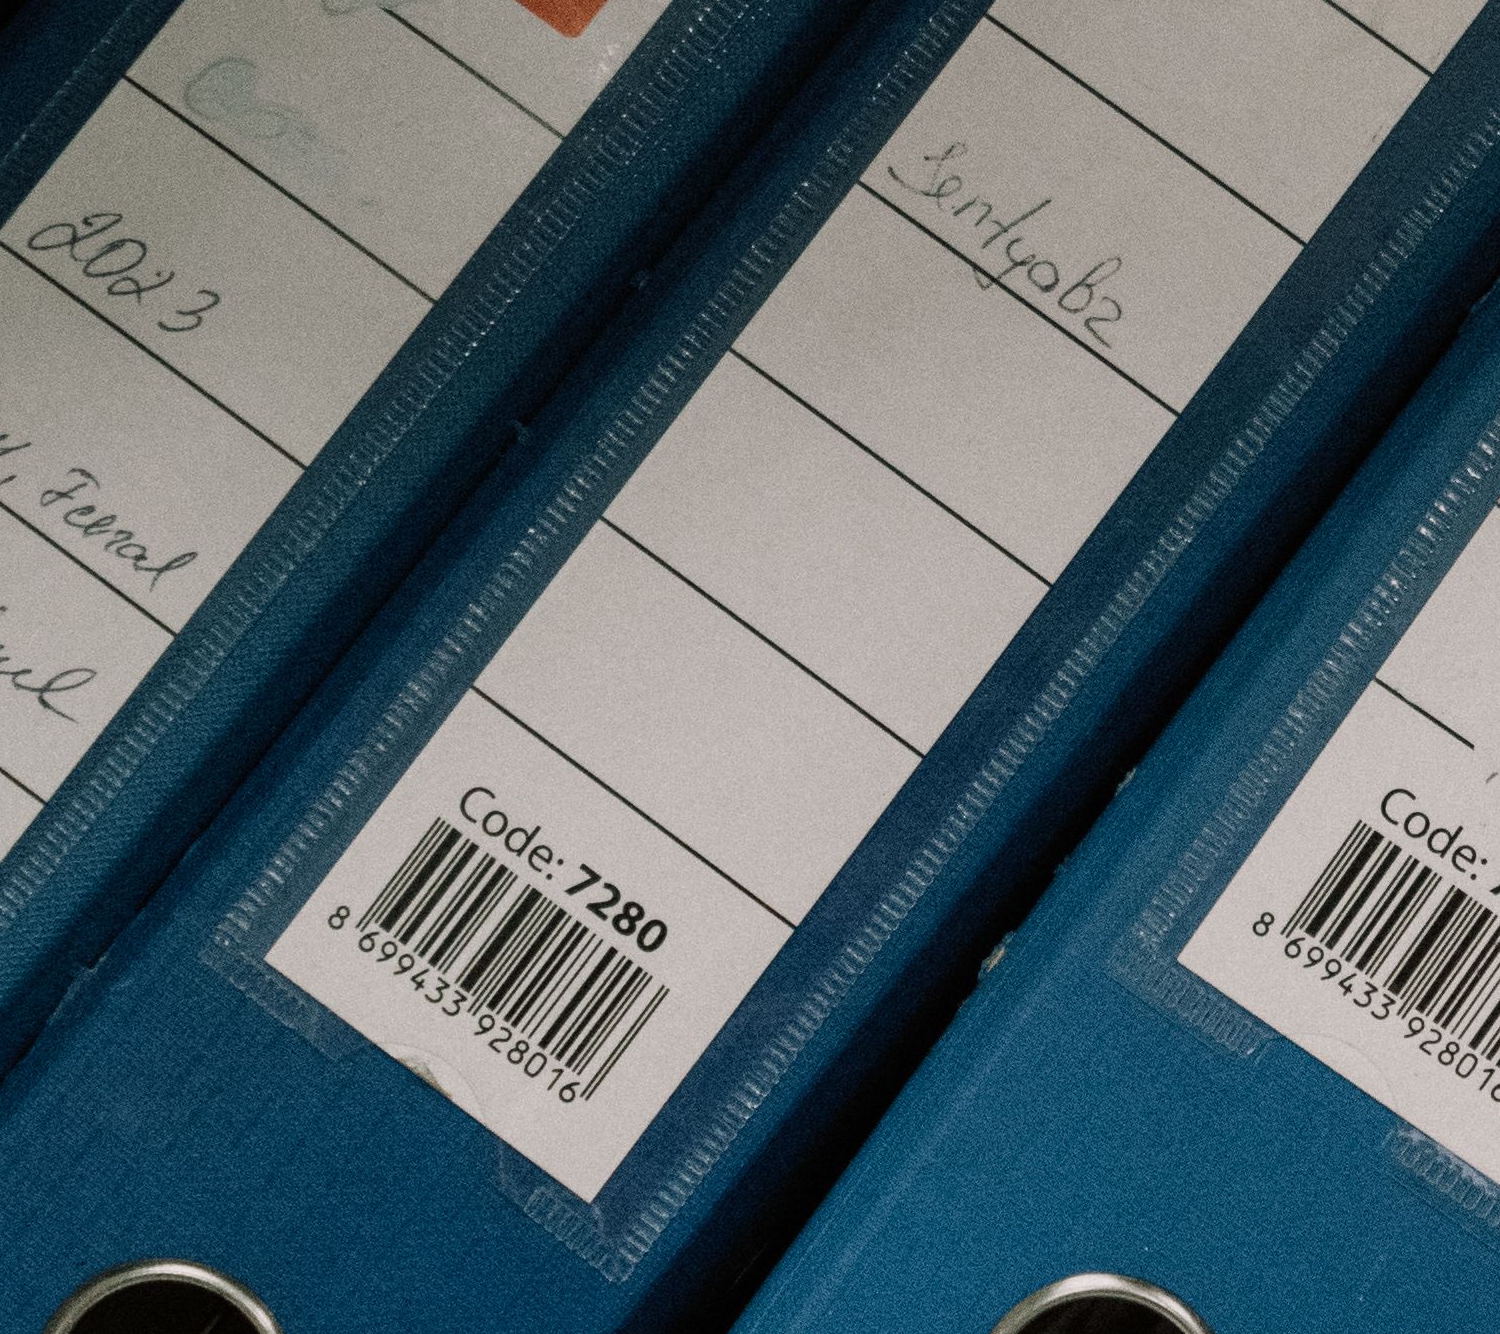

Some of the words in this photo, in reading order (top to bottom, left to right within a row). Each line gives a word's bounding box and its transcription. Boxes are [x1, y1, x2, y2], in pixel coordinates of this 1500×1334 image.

[27, 213, 219, 332] 2023
[459, 786, 566, 880] Code:
[566, 863, 668, 953] 7280
[1380, 788, 1488, 880] Code:
[329, 905, 350, 931] 8
[358, 931, 466, 1017] 699433
[477, 1014, 580, 1104] 928016
[1253, 912, 1274, 937] 8
[1284, 936, 1394, 1019] 699433
